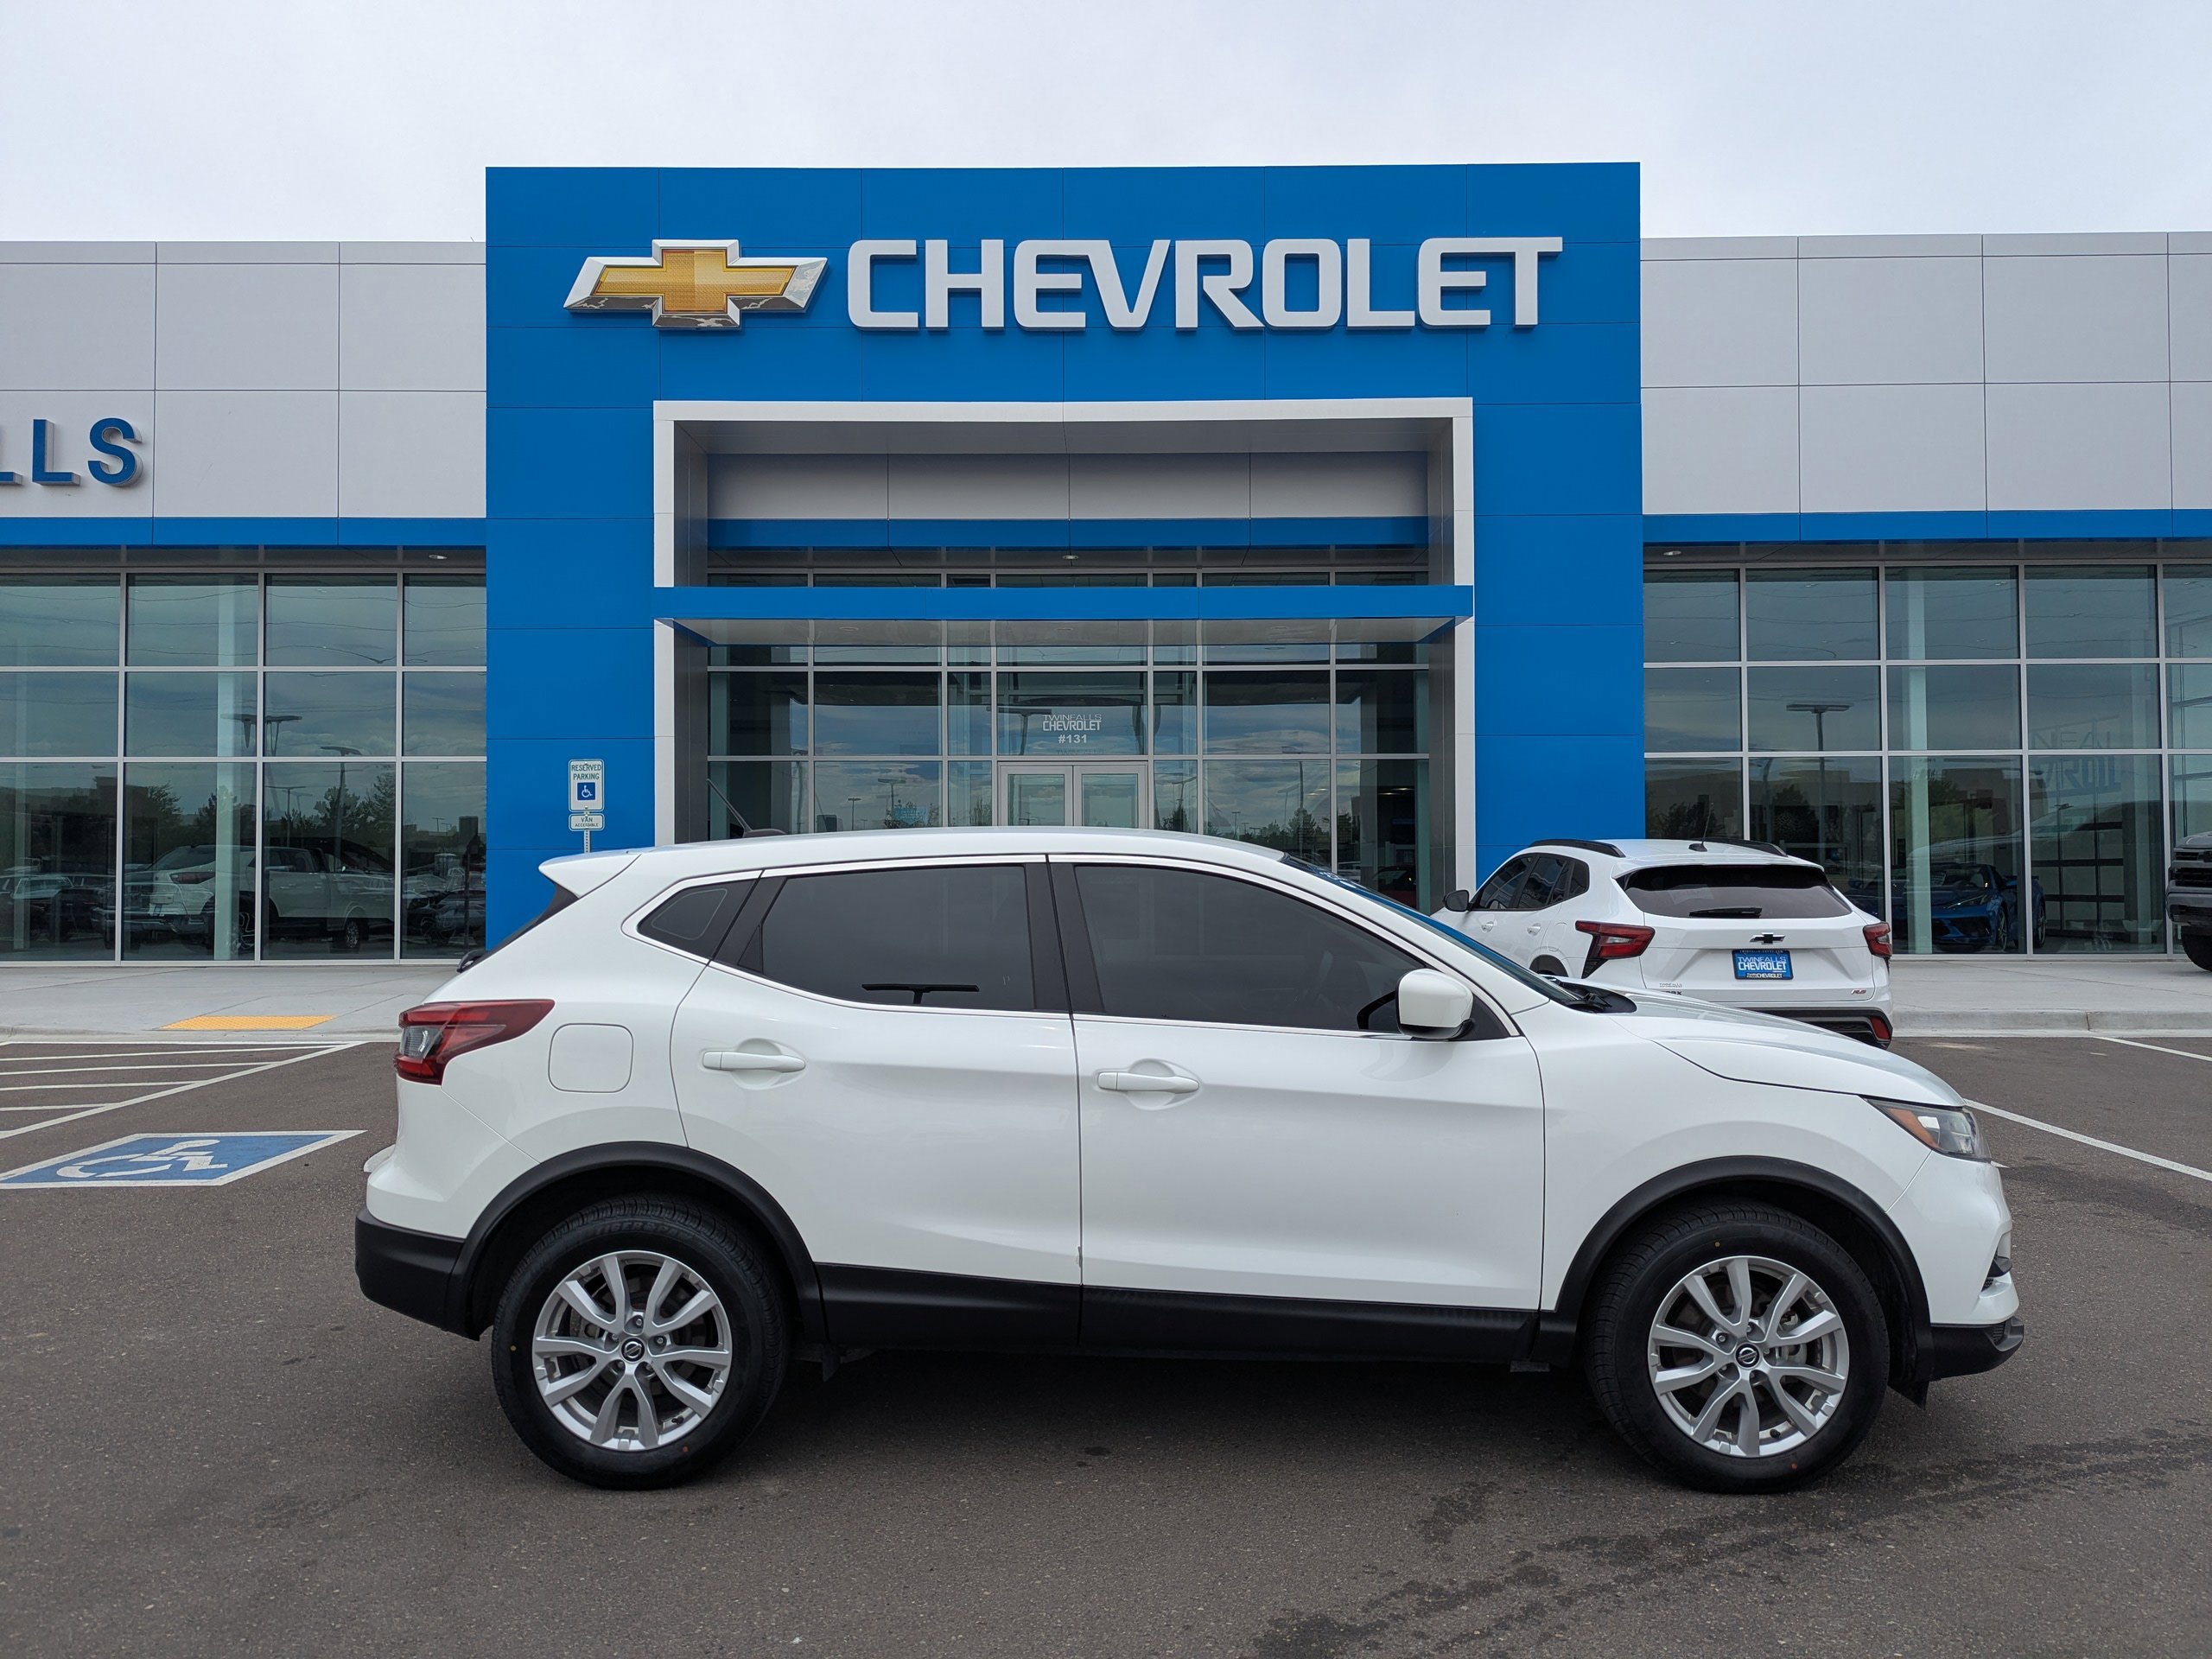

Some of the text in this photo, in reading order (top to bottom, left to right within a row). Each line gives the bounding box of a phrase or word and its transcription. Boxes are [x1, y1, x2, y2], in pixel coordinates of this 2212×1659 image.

[847, 236, 1564, 331] CHEVROLET
[1042, 721, 1102, 731] CHEVROLET
[1058, 734, 1087, 744] #131
[1738, 962, 1786, 970] CHEVROLET
